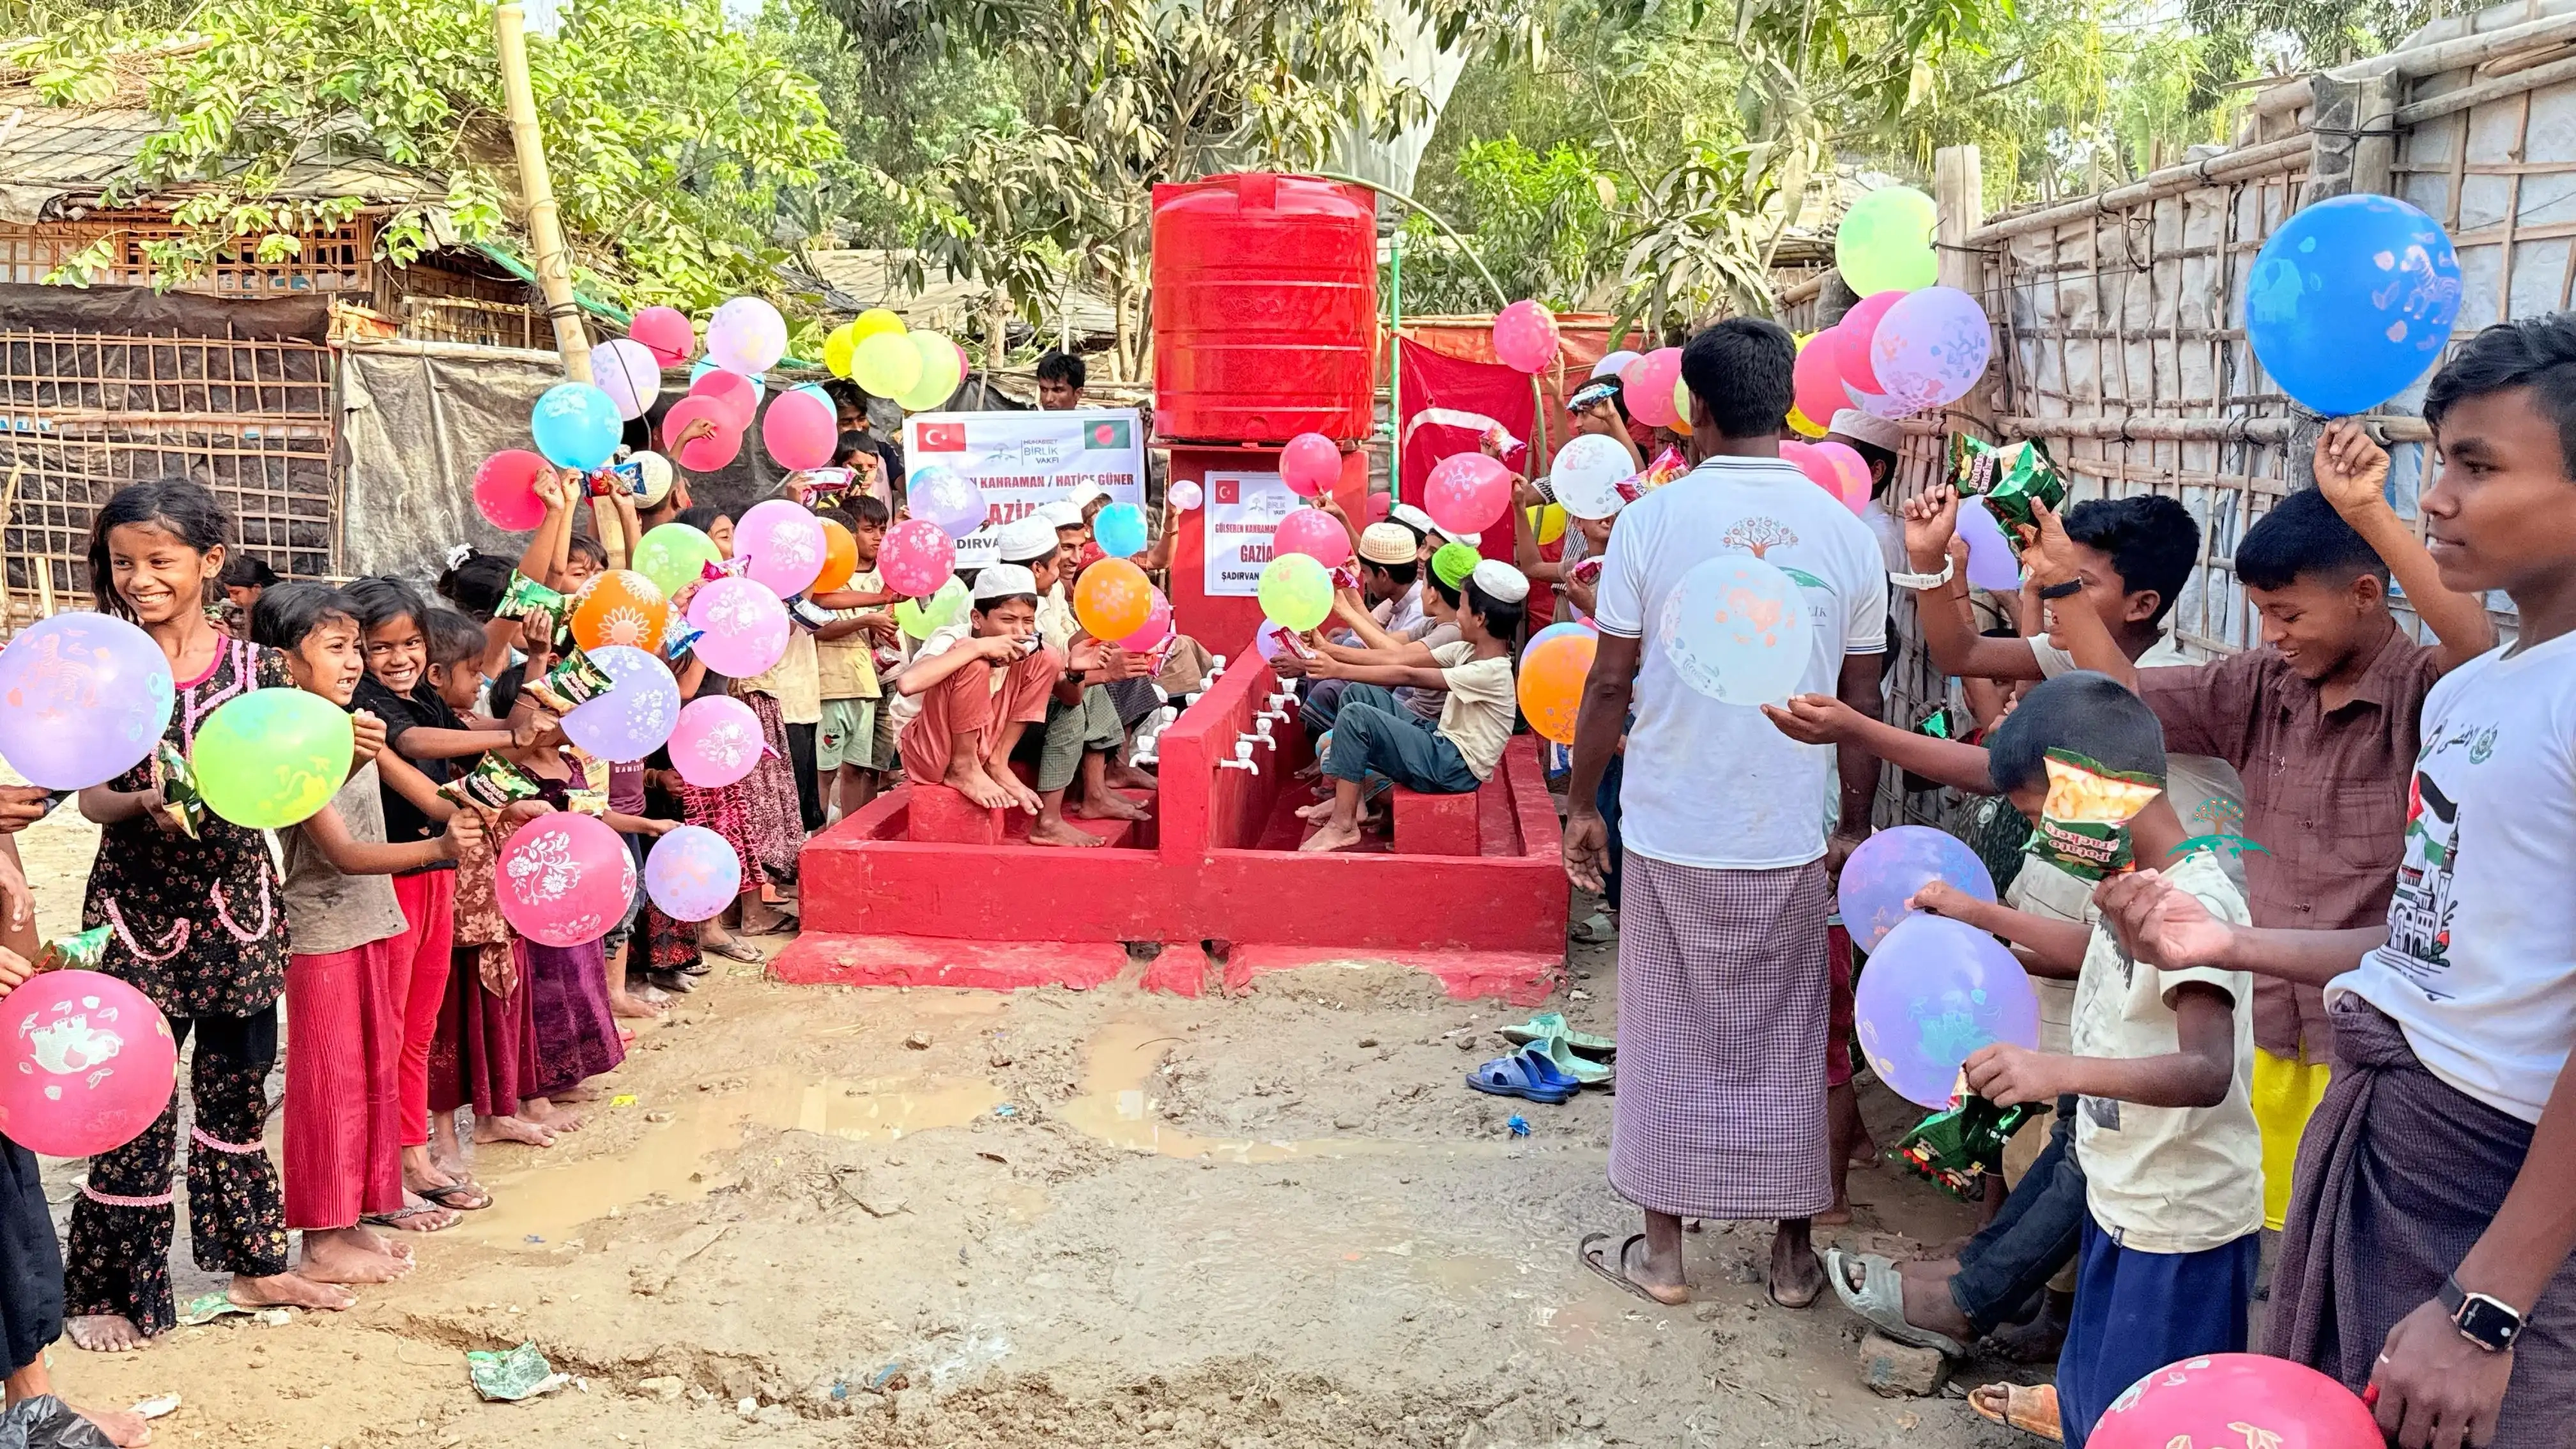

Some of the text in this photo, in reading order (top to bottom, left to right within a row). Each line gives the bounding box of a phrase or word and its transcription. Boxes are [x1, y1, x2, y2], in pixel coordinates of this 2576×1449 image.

[1023, 445, 1059, 456] BİRLİK
[980, 475, 1045, 489] KAHRAMAN
[1098, 472, 1135, 486] GÜNER
[1222, 572, 1259, 582] ŞADIRVAN
[2048, 839, 2112, 862] Potato
